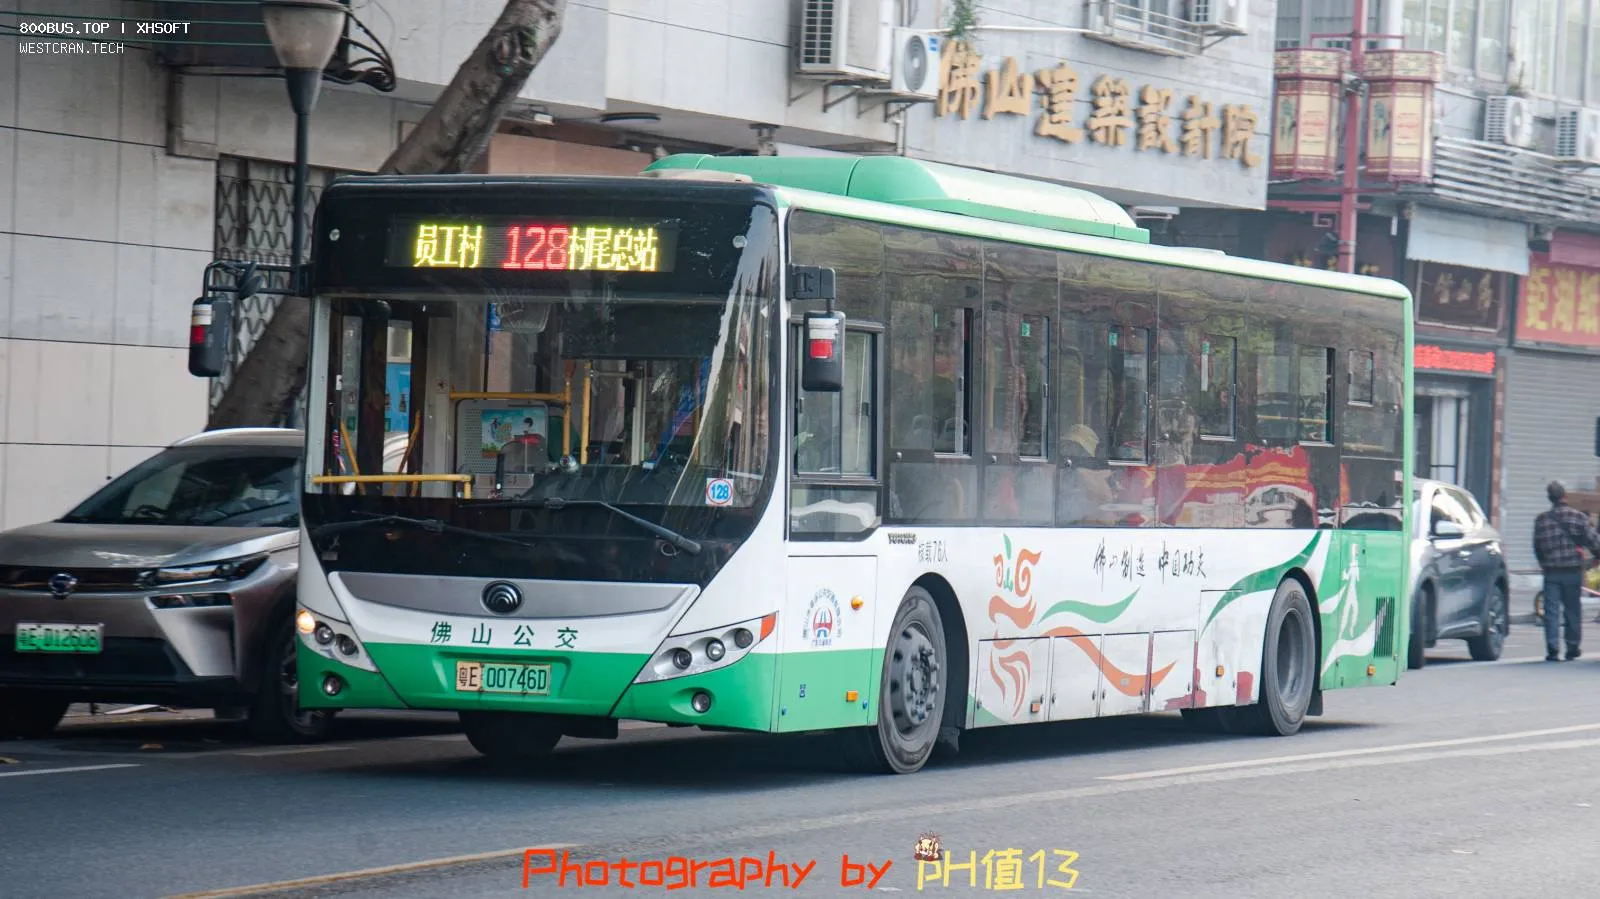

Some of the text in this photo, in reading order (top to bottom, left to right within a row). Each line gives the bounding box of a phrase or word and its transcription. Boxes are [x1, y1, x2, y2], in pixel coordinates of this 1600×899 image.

[413, 224, 658, 272] 员工村 128 村尾总站
[711, 484, 729, 500] 128
[430, 621, 579, 649] 佛山公交
